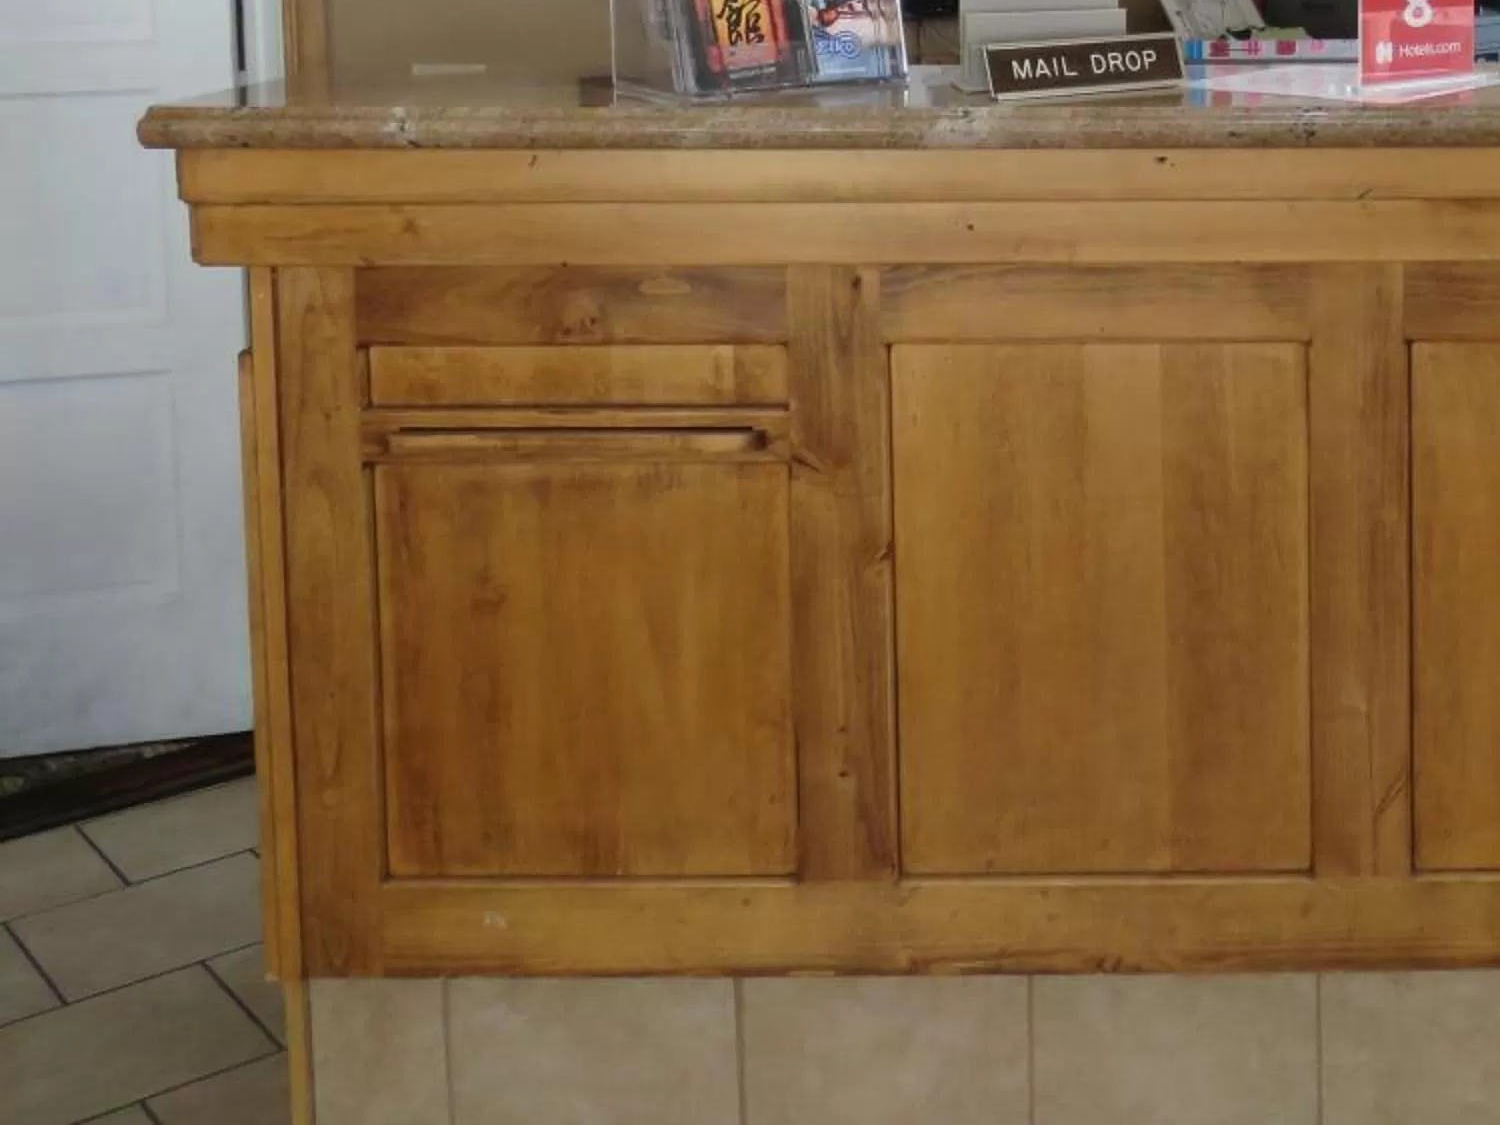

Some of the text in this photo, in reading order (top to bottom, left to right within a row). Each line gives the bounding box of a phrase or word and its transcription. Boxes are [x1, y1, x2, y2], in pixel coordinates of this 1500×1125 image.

[1399, 41, 1462, 59] Hotels.com
[1011, 49, 1158, 80] MAIL DROP
